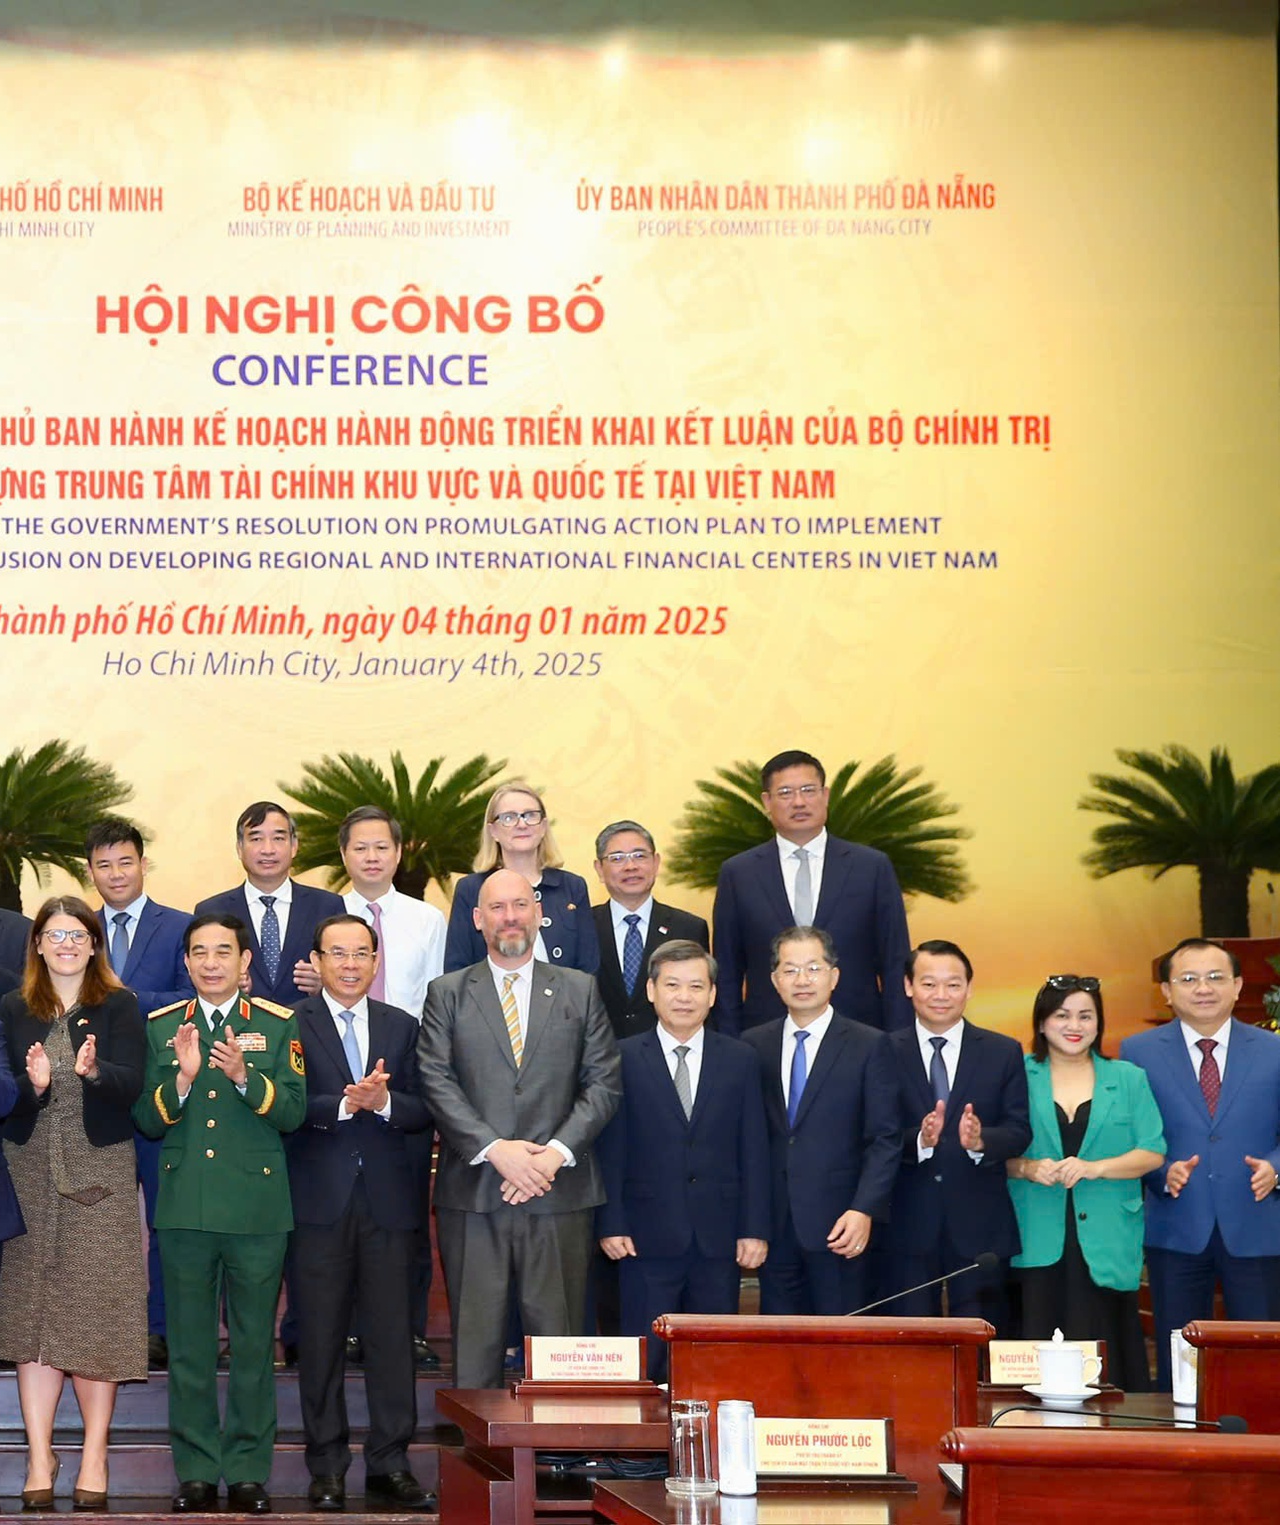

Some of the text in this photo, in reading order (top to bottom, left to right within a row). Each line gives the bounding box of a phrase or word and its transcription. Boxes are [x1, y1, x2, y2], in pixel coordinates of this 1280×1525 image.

[34, 179, 62, 213] HỒ
[68, 181, 102, 212] CHÍ
[108, 186, 163, 212] MINH
[243, 180, 270, 217] BỘ
[277, 178, 307, 212] KẾ
[310, 186, 380, 217] HOẠCH
[387, 181, 414, 212] VÀ
[468, 184, 496, 212] TƯ
[577, 173, 996, 211] ỦY BAN NHÂN DÂN THÀNH PHỐ ĐÀ NẴNG
[19, 221, 59, 238] MINH
[63, 221, 95, 238] CITY
[228, 220, 511, 238] MINISTRY OF PLANNING AND INVESTMENT
[710, 219, 798, 237] COMMITTEE
[803, 219, 820, 236] OF
[826, 220, 846, 236] DA
[852, 219, 894, 235] NANG
[899, 218, 931, 235] CITY
[96, 275, 605, 347] HỘI NGHỊ CÔNG BỐ
[212, 354, 488, 386] CONFERENCE
[45, 417, 100, 446] BAN
[110, 411, 184, 446] HÀNH
[194, 407, 228, 446] KẾ
[237, 417, 327, 453] HOẠCH
[337, 410, 410, 446] HÀNH
[420, 410, 494, 453] ĐỘNG
[503, 404, 582, 446] TRIỂN
[592, 416, 655, 446] KHAI
[665, 407, 714, 446] KẾT
[723, 409, 794, 452] LUẬN
[804, 406, 859, 446] CỦA
[868, 409, 904, 452] BỘ
[914, 409, 999, 446] CHÍNH
[1008, 415, 1051, 452] TRỊ
[55, 470, 144, 500] TRUNG
[153, 464, 211, 500] TÂM
[220, 464, 261, 500] TÀI
[272, 464, 354, 500] CHÍNH
[364, 470, 418, 500] KHU
[427, 467, 480, 506] VỰC
[489, 464, 523, 500] VÀ
[533, 459, 605, 503] QUỐC
[614, 460, 646, 500] TẾ
[654, 470, 696, 506] TẠI
[705, 463, 762, 506] VIỆT
[772, 469, 835, 499] NAM
[1, 517, 44, 535] THE
[236, 517, 377, 535] RESOLUTION
[385, 517, 417, 535] ON
[425, 517, 606, 535] PROMULGATING
[613, 517, 698, 535] ACTION
[706, 517, 765, 535] PLAN
[771, 517, 801, 535] TO
[808, 517, 942, 535] IMPLEMENT
[69, 551, 101, 569] ON
[109, 551, 251, 569] DEVELOPING
[259, 551, 373, 569] REGIONAL
[380, 551, 429, 569] AND
[436, 551, 617, 569] INTERNATIONAL
[624, 551, 746, 569] FINANCIAL
[752, 551, 852, 569] CENTERS
[859, 551, 881, 569] IN
[887, 551, 937, 569] VIET
[944, 551, 998, 569] NAM
[71, 601, 134, 643] phố
[135, 600, 176, 635] Hồ
[182, 604, 229, 635] Chí
[231, 604, 314, 640] Minh,
[322, 605, 396, 644] ngày
[402, 606, 438, 635] 04
[445, 604, 532, 643] tháng
[539, 606, 573, 636] 01
[581, 606, 647, 635] năm
[654, 606, 728, 635] 2025
[103, 649, 603, 683] Ho Chi Minh City, January 4th, 2025
